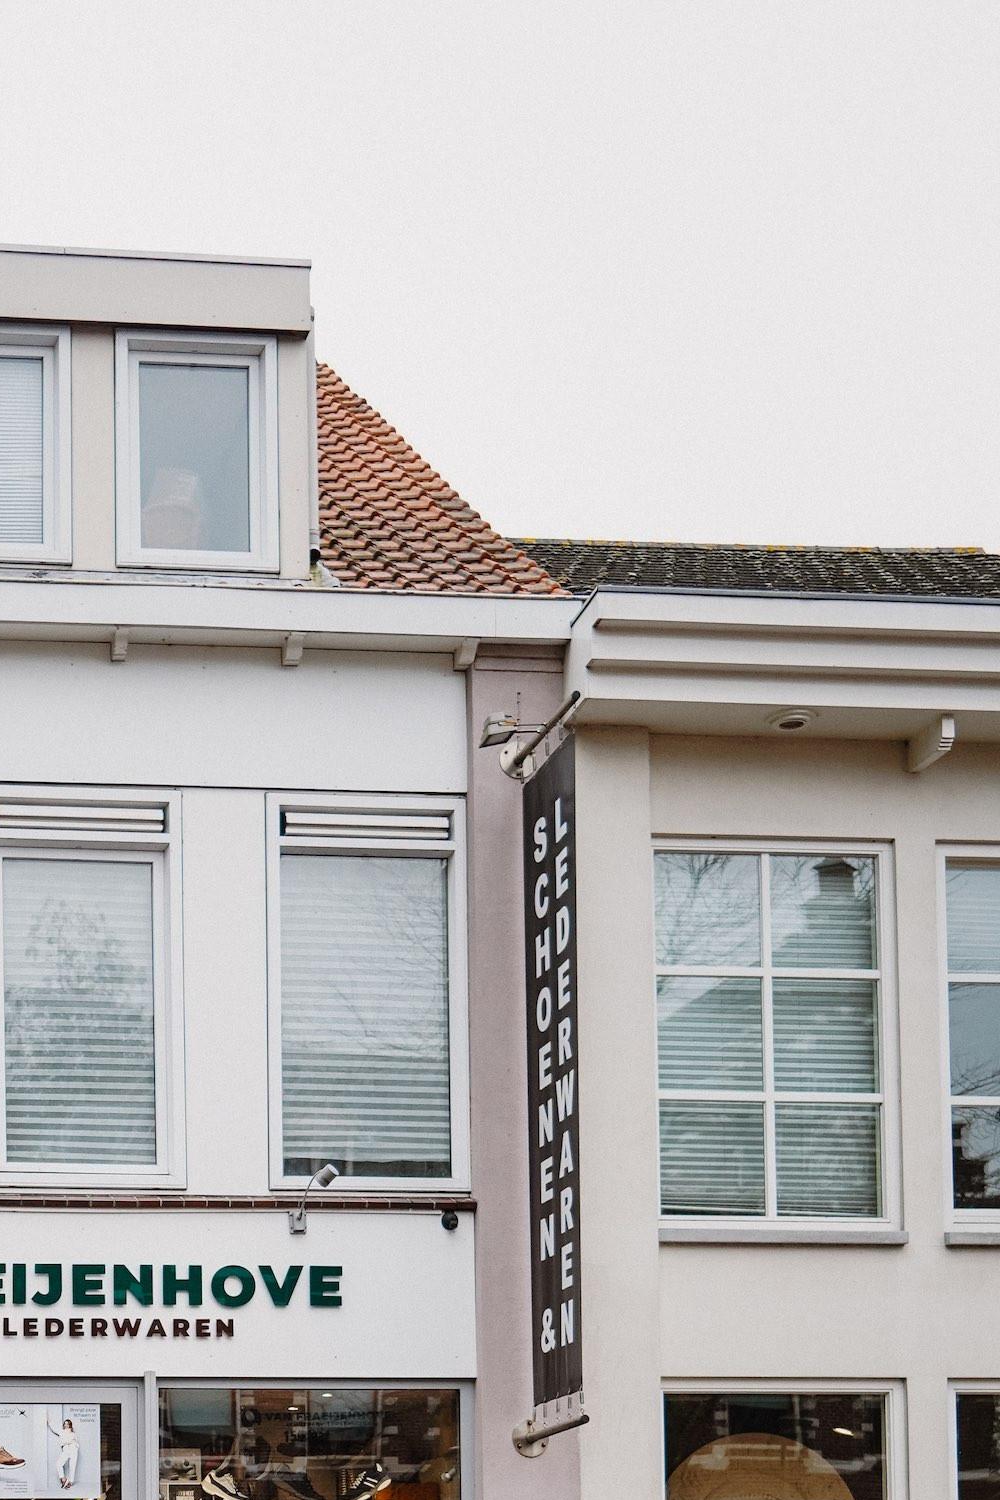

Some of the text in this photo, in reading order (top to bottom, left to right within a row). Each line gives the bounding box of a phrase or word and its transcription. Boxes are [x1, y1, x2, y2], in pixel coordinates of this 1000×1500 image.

[3, 1317, 235, 1338] LEDERWAREN
[534, 816, 556, 1353] SCHOENEN &
[555, 798, 575, 1347] LEDERWAREN
